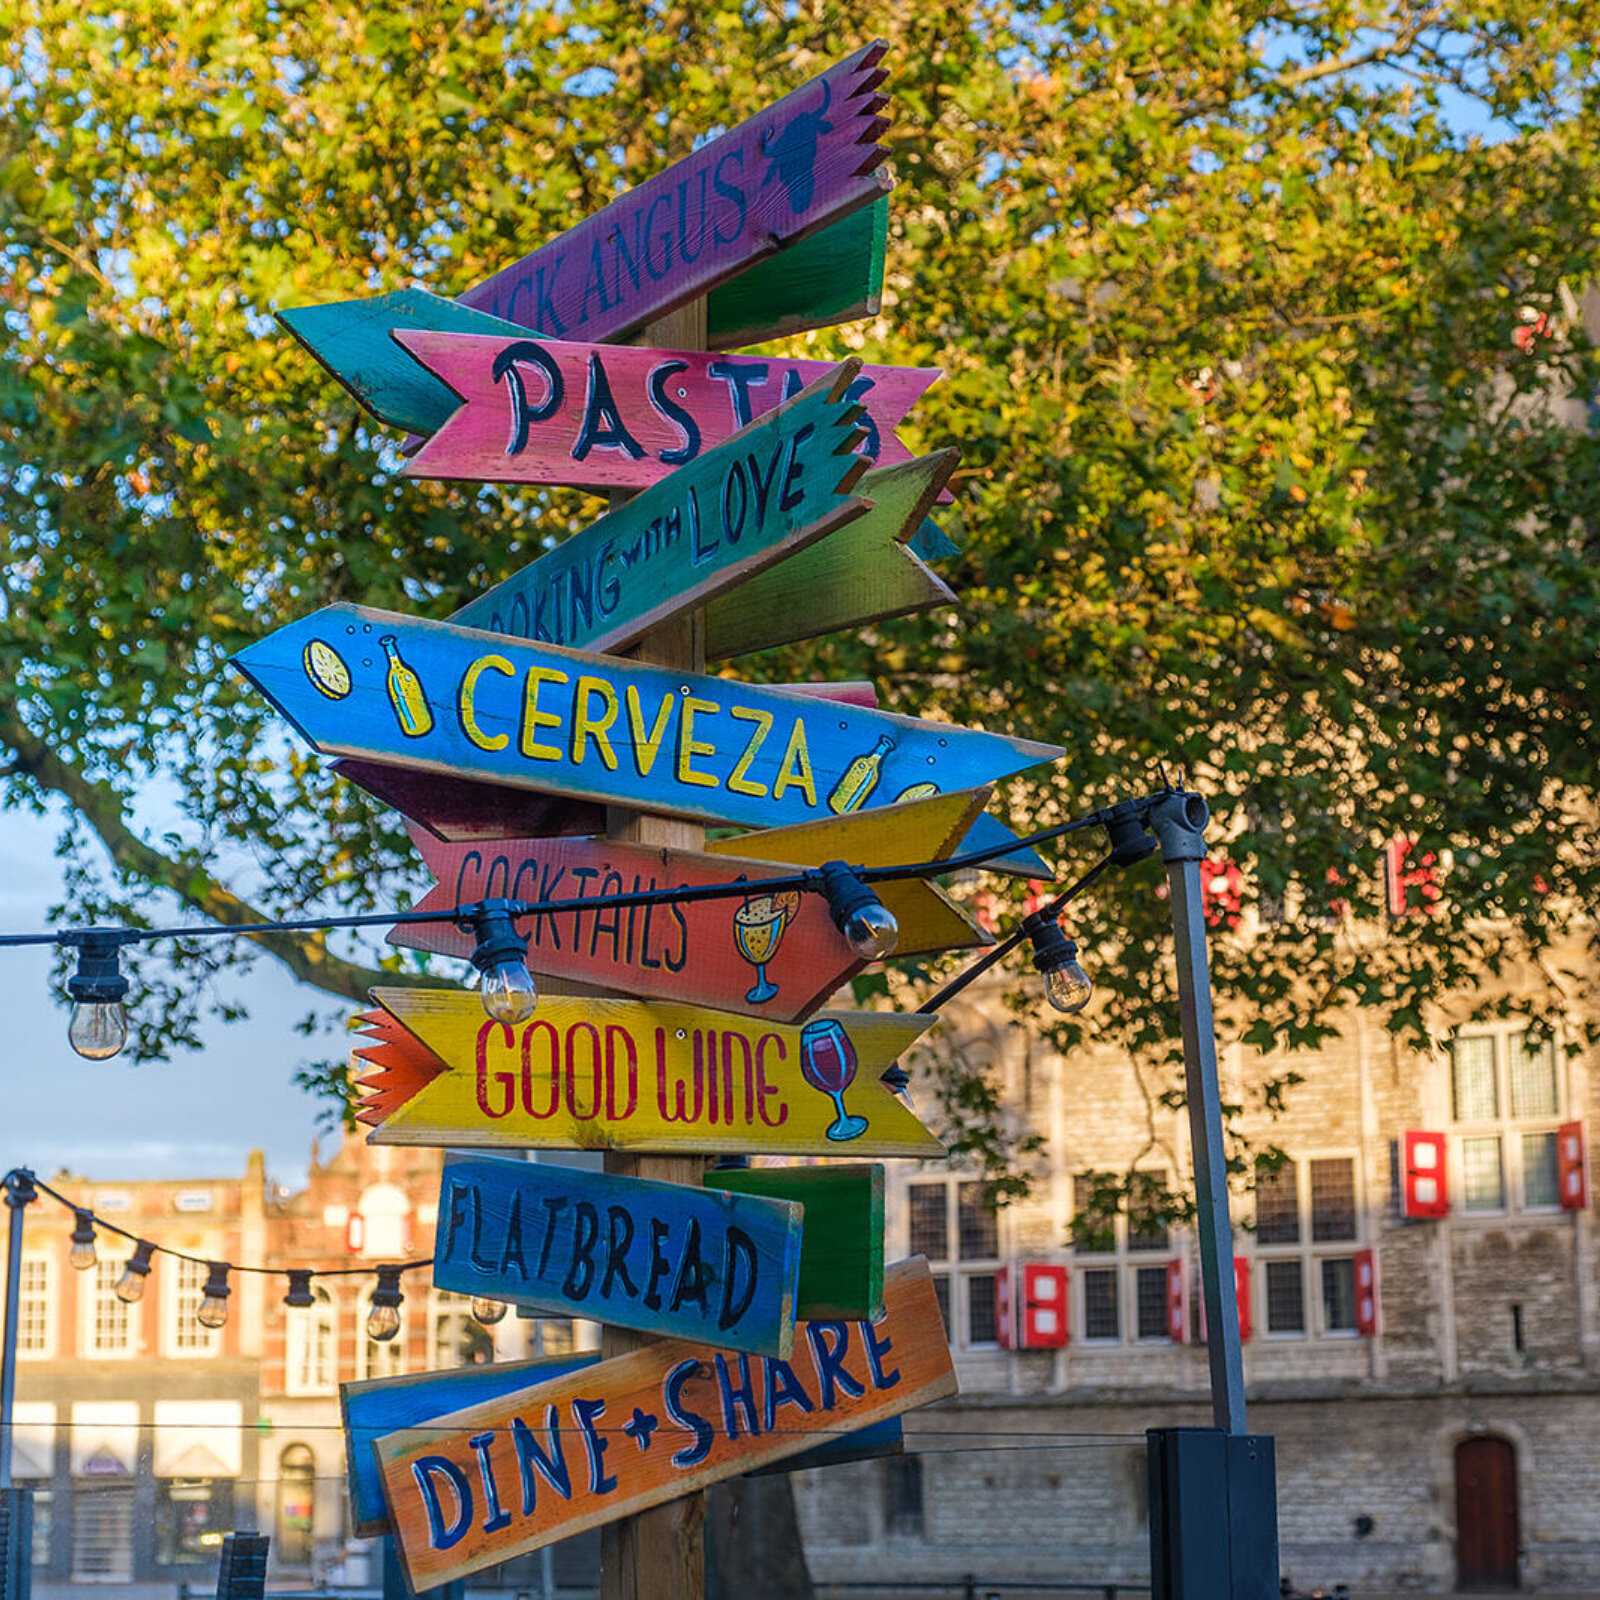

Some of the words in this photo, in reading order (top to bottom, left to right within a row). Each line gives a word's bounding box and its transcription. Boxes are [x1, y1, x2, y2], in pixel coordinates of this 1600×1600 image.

[491, 254, 568, 338] CK
[578, 147, 749, 325] ANGUS
[620, 506, 682, 568] WITH
[688, 422, 815, 568] LOVE
[459, 654, 817, 807] CERVEZA
[476, 1019, 640, 1122] GOOD
[655, 1027, 789, 1128] WINE
[444, 1177, 759, 1333] FLATBREAD
[411, 1398, 619, 1551] DINE
[662, 1320, 901, 1468] SHARE
